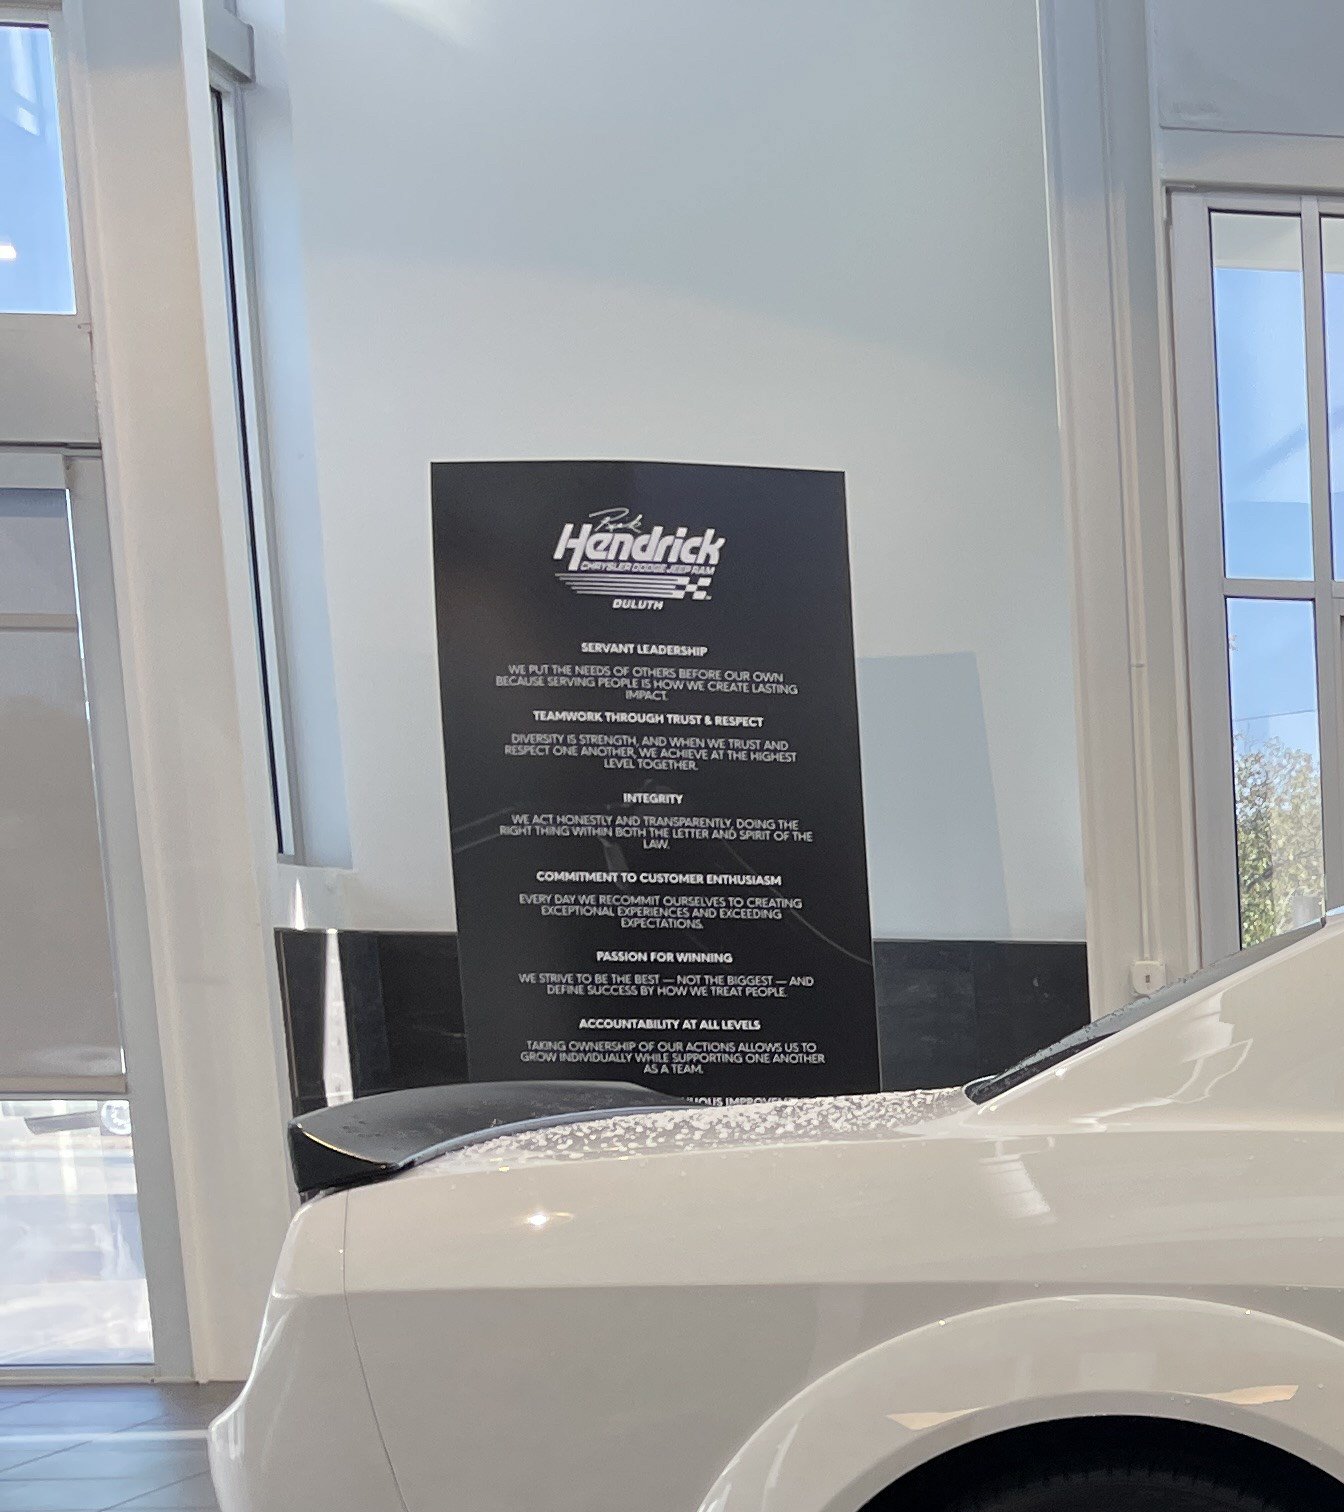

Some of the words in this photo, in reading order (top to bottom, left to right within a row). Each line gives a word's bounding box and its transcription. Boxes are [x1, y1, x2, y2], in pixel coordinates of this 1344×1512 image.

[553, 523, 726, 571] Hendrick
[580, 560, 632, 572] CHRYSLER
[631, 562, 668, 573] DODGE
[666, 564, 692, 574] JEEP
[691, 565, 716, 575] RAM
[611, 598, 664, 609] DULUTH
[580, 642, 634, 653] SERVANT
[636, 644, 708, 656] LEADERSHIP
[507, 664, 526, 674] WE
[528, 664, 548, 674] PUT
[552, 664, 571, 675] THE
[574, 665, 611, 676] NEEDS
[612, 665, 628, 676] OF
[631, 666, 676, 678] OTHERS
[678, 668, 721, 679] BEFORE
[723, 670, 750, 681] OUR
[752, 671, 785, 682] OWN
[495, 675, 544, 687] BECAUSE
[546, 676, 595, 687] SERVING
[597, 677, 638, 688] PEOPLE
[640, 678, 651, 688] IS
[652, 679, 684, 689] HOW
[685, 680, 704, 691] WE
[706, 681, 749, 692] CREATE
[751, 683, 798, 694] LASTING
[624, 689, 668, 700] IMPACT.
[532, 710, 602, 722] TEAMWORK
[604, 711, 664, 723] THROUGH
[666, 713, 702, 724] TRUST
[704, 715, 712, 725] &
[714, 715, 764, 727] RESPECT
[509, 732, 564, 744] DIVERSITY
[578, 734, 639, 745] STRENGTH,
[641, 736, 667, 746] AND
[668, 737, 705, 747] WHEN
[706, 738, 725, 748] WE
[728, 738, 760, 749] TRUST
[763, 740, 789, 750] AND
[503, 744, 549, 756] RESPECT
[552, 745, 577, 756] ONE
[580, 745, 637, 757] ANOTHER,
[638, 747, 657, 758] WE
[659, 748, 708, 759] ACHIEVE
[710, 749, 724, 759] AT
[727, 749, 747, 760] THE
[749, 751, 797, 762] HIGHEST
[602, 757, 633, 768] LEVEL
[637, 758, 699, 770] TOGETHER.
[622, 792, 684, 804] INTEGRITY
[510, 813, 528, 824] WE
[531, 813, 553, 824] ACT
[556, 814, 612, 825] HONESTLY
[614, 815, 640, 826] AND
[643, 815, 734, 828] TRANSPARENTLY,
[735, 818, 775, 829] DOING
[778, 819, 800, 830] THE
[498, 824, 532, 835] RIGHT
[534, 824, 570, 836] THING
[571, 826, 613, 836] WITHIN
[614, 826, 646, 837] BOTH
[649, 827, 668, 837] THE
[671, 827, 709, 839] LETTER
[711, 829, 737, 839] AND
[738, 829, 770, 840] SPIRIT
[772, 830, 789, 841] OF
[792, 831, 813, 842] THE
[641, 838, 670, 849] LAW.
[535, 870, 618, 882] COMMITMENT
[620, 872, 637, 882] TO
[639, 872, 703, 884] CUSTOMER
[706, 874, 782, 885] ENTHUSIASM
[518, 893, 552, 904] EVERY
[553, 894, 576, 904] DAY
[577, 894, 595, 904] WE
[598, 894, 659, 906] RECOMMIT
[662, 895, 726, 907] OURSELVES
[728, 896, 744, 907] TO
[746, 897, 803, 908] CREATING
[540, 904, 613, 917] EXCEPTIONAL
[616, 905, 689, 917] EXPERIENCES
[691, 907, 717, 918] AND
[718, 907, 783, 919] EXCEEDING
[619, 917, 704, 929] EXPECTATIONS.
[595, 950, 647, 962] PASSION
[649, 951, 674, 962] FOR
[675, 951, 733, 963] WINNING
[517, 972, 535, 983] WE
[538, 972, 573, 983] STRIVE
[576, 973, 592, 984] TO
[593, 973, 608, 984] BE
[611, 973, 631, 984] THE
[633, 973, 659, 984] BEST
[676, 974, 700, 985] NOT
[704, 974, 724, 985] THE
[726, 974, 772, 986] BIGGEST
[788, 976, 815, 986] AND
[545, 983, 584, 995] DEFINE
[586, 984, 638, 996] SUCCESS
[639, 985, 654, 995] BY
[656, 985, 688, 996] HOW
[689, 986, 707, 996] WE
[710, 985, 742, 996] TREAT
[744, 986, 789, 997] PEOPLE.
[578, 1017, 679, 1030] ACCOUNTABILITY
[681, 1019, 696, 1029] AT
[699, 1019, 719, 1029] ALL
[721, 1019, 762, 1030] LEVELS
[524, 1040, 566, 1050] TAKING
[568, 1040, 636, 1052] OWNERSHIP
[638, 1041, 654, 1051] OF
[656, 1041, 683, 1052] OUR
[685, 1041, 735, 1052] ACTIONS
[737, 1041, 782, 1052] ALLOWS
[784, 1042, 799, 1052] US
[801, 1042, 818, 1052] TO
[519, 1051, 557, 1062] GROW
[558, 1051, 632, 1063] INDIVIDUALLY
[634, 1052, 668, 1062] WHILE
[671, 1051, 743, 1063] SUPPORTING
[744, 1052, 770, 1063] ONE
[771, 1053, 827, 1064] ANOTHER
[643, 1063, 658, 1073] AS
[671, 1063, 704, 1074] TEAM.
